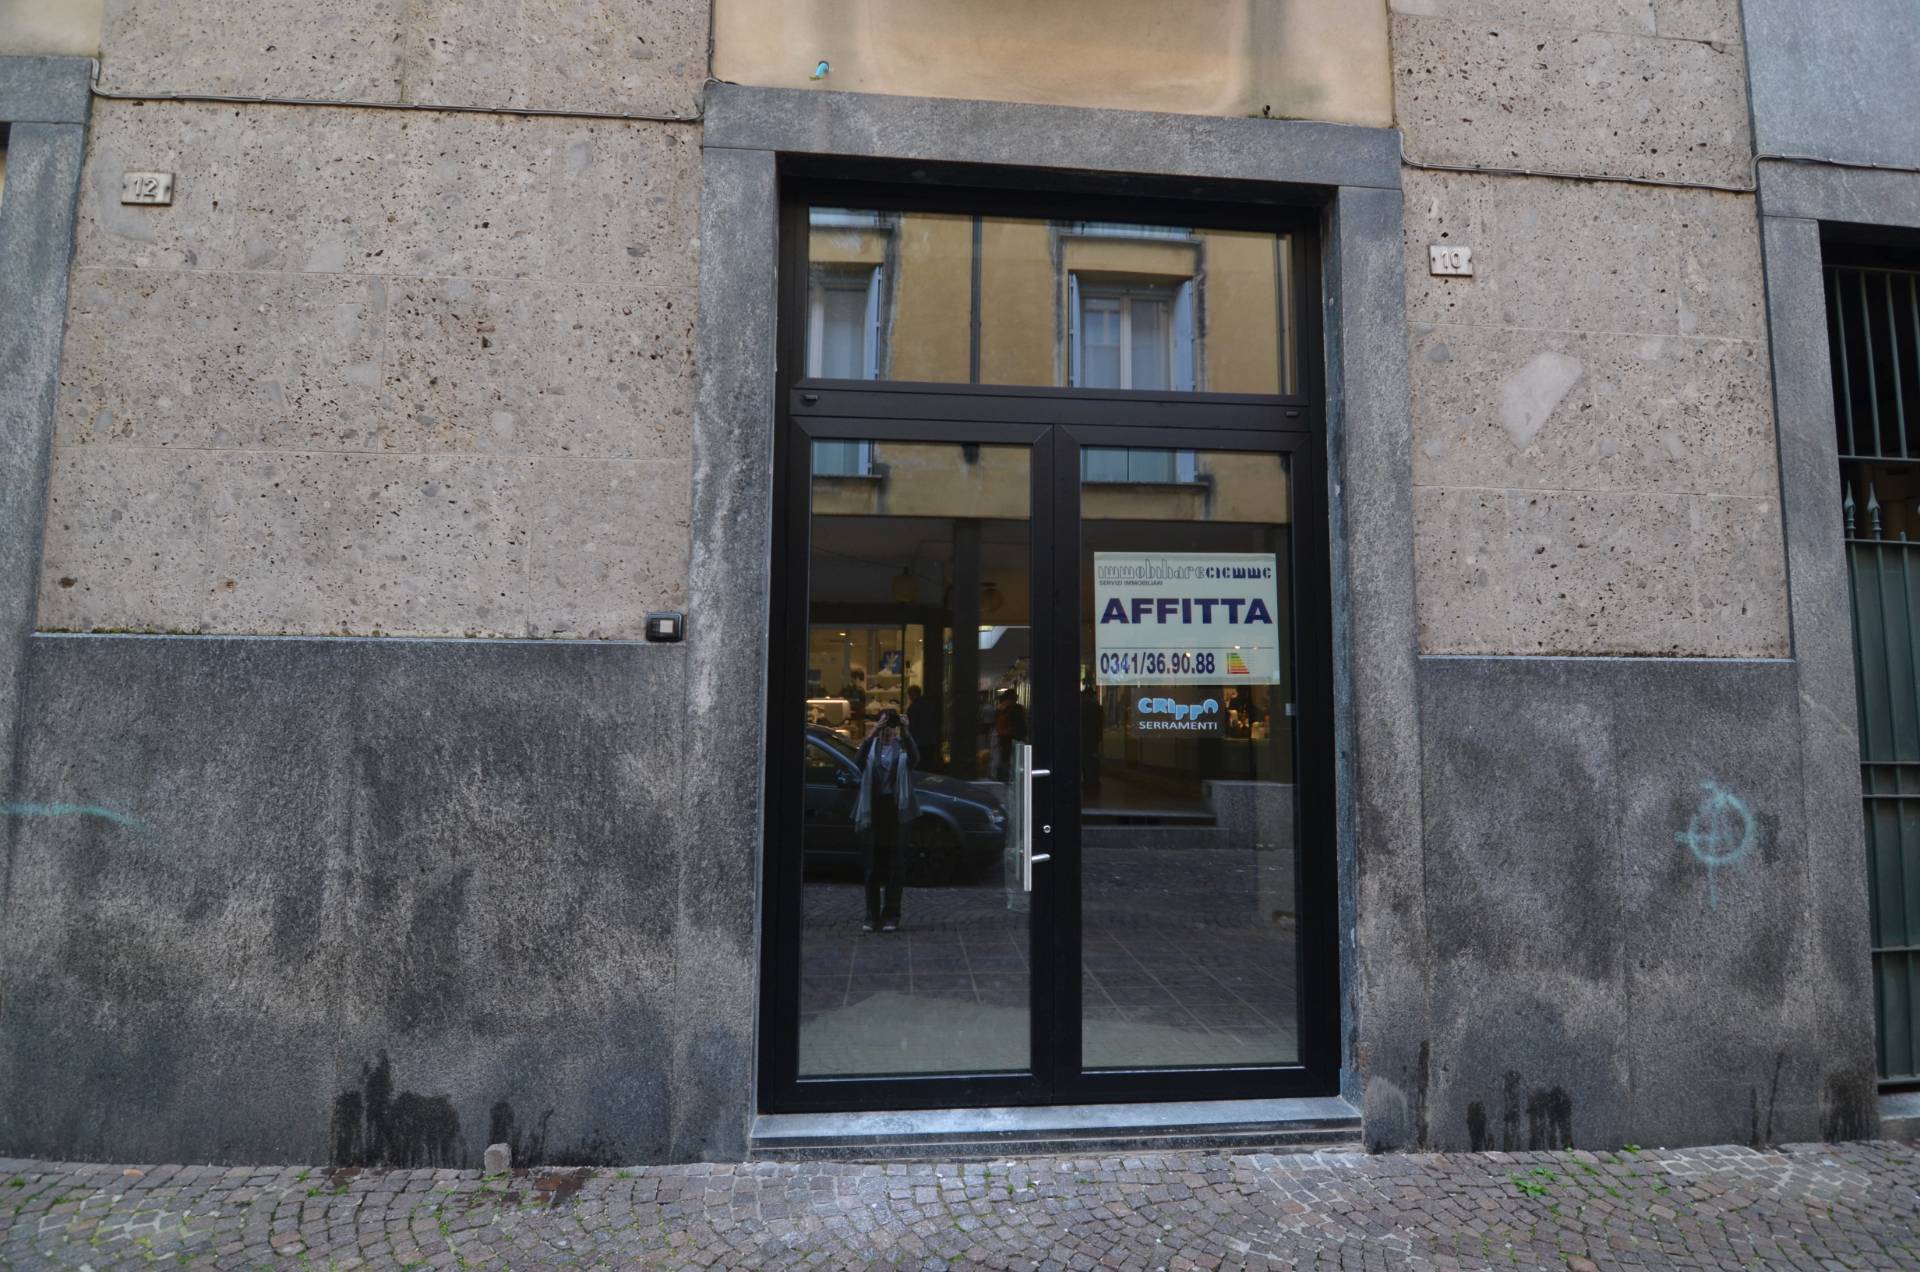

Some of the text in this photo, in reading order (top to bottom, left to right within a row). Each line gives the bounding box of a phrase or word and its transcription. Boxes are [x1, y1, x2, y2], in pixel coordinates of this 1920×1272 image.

[134, 176, 159, 197] 12
[1441, 251, 1461, 269] 10
[1100, 598, 1273, 624] AFFITTA
[1100, 652, 1216, 675] 0341/36.90.88
[1138, 721, 1218, 730] SERRAMENTI
